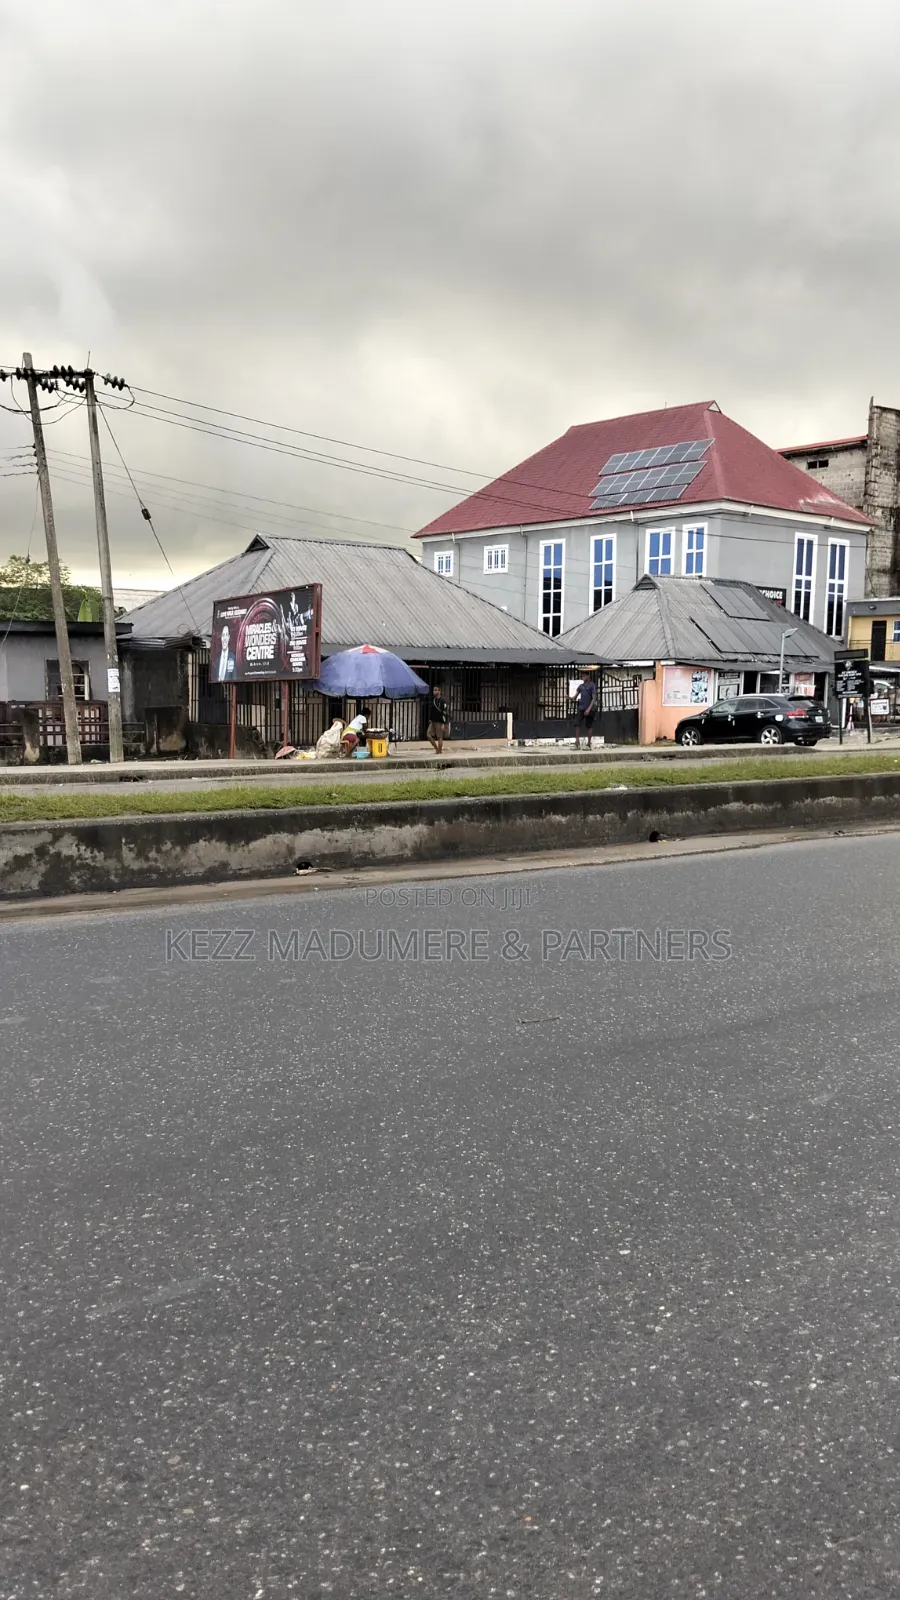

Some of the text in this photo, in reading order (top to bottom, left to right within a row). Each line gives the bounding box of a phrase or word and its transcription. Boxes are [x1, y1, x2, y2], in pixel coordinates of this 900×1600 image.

[246, 622, 271, 635] MIRACLES
[245, 632, 277, 647] WONDERS
[246, 645, 274, 660] CENTRE
